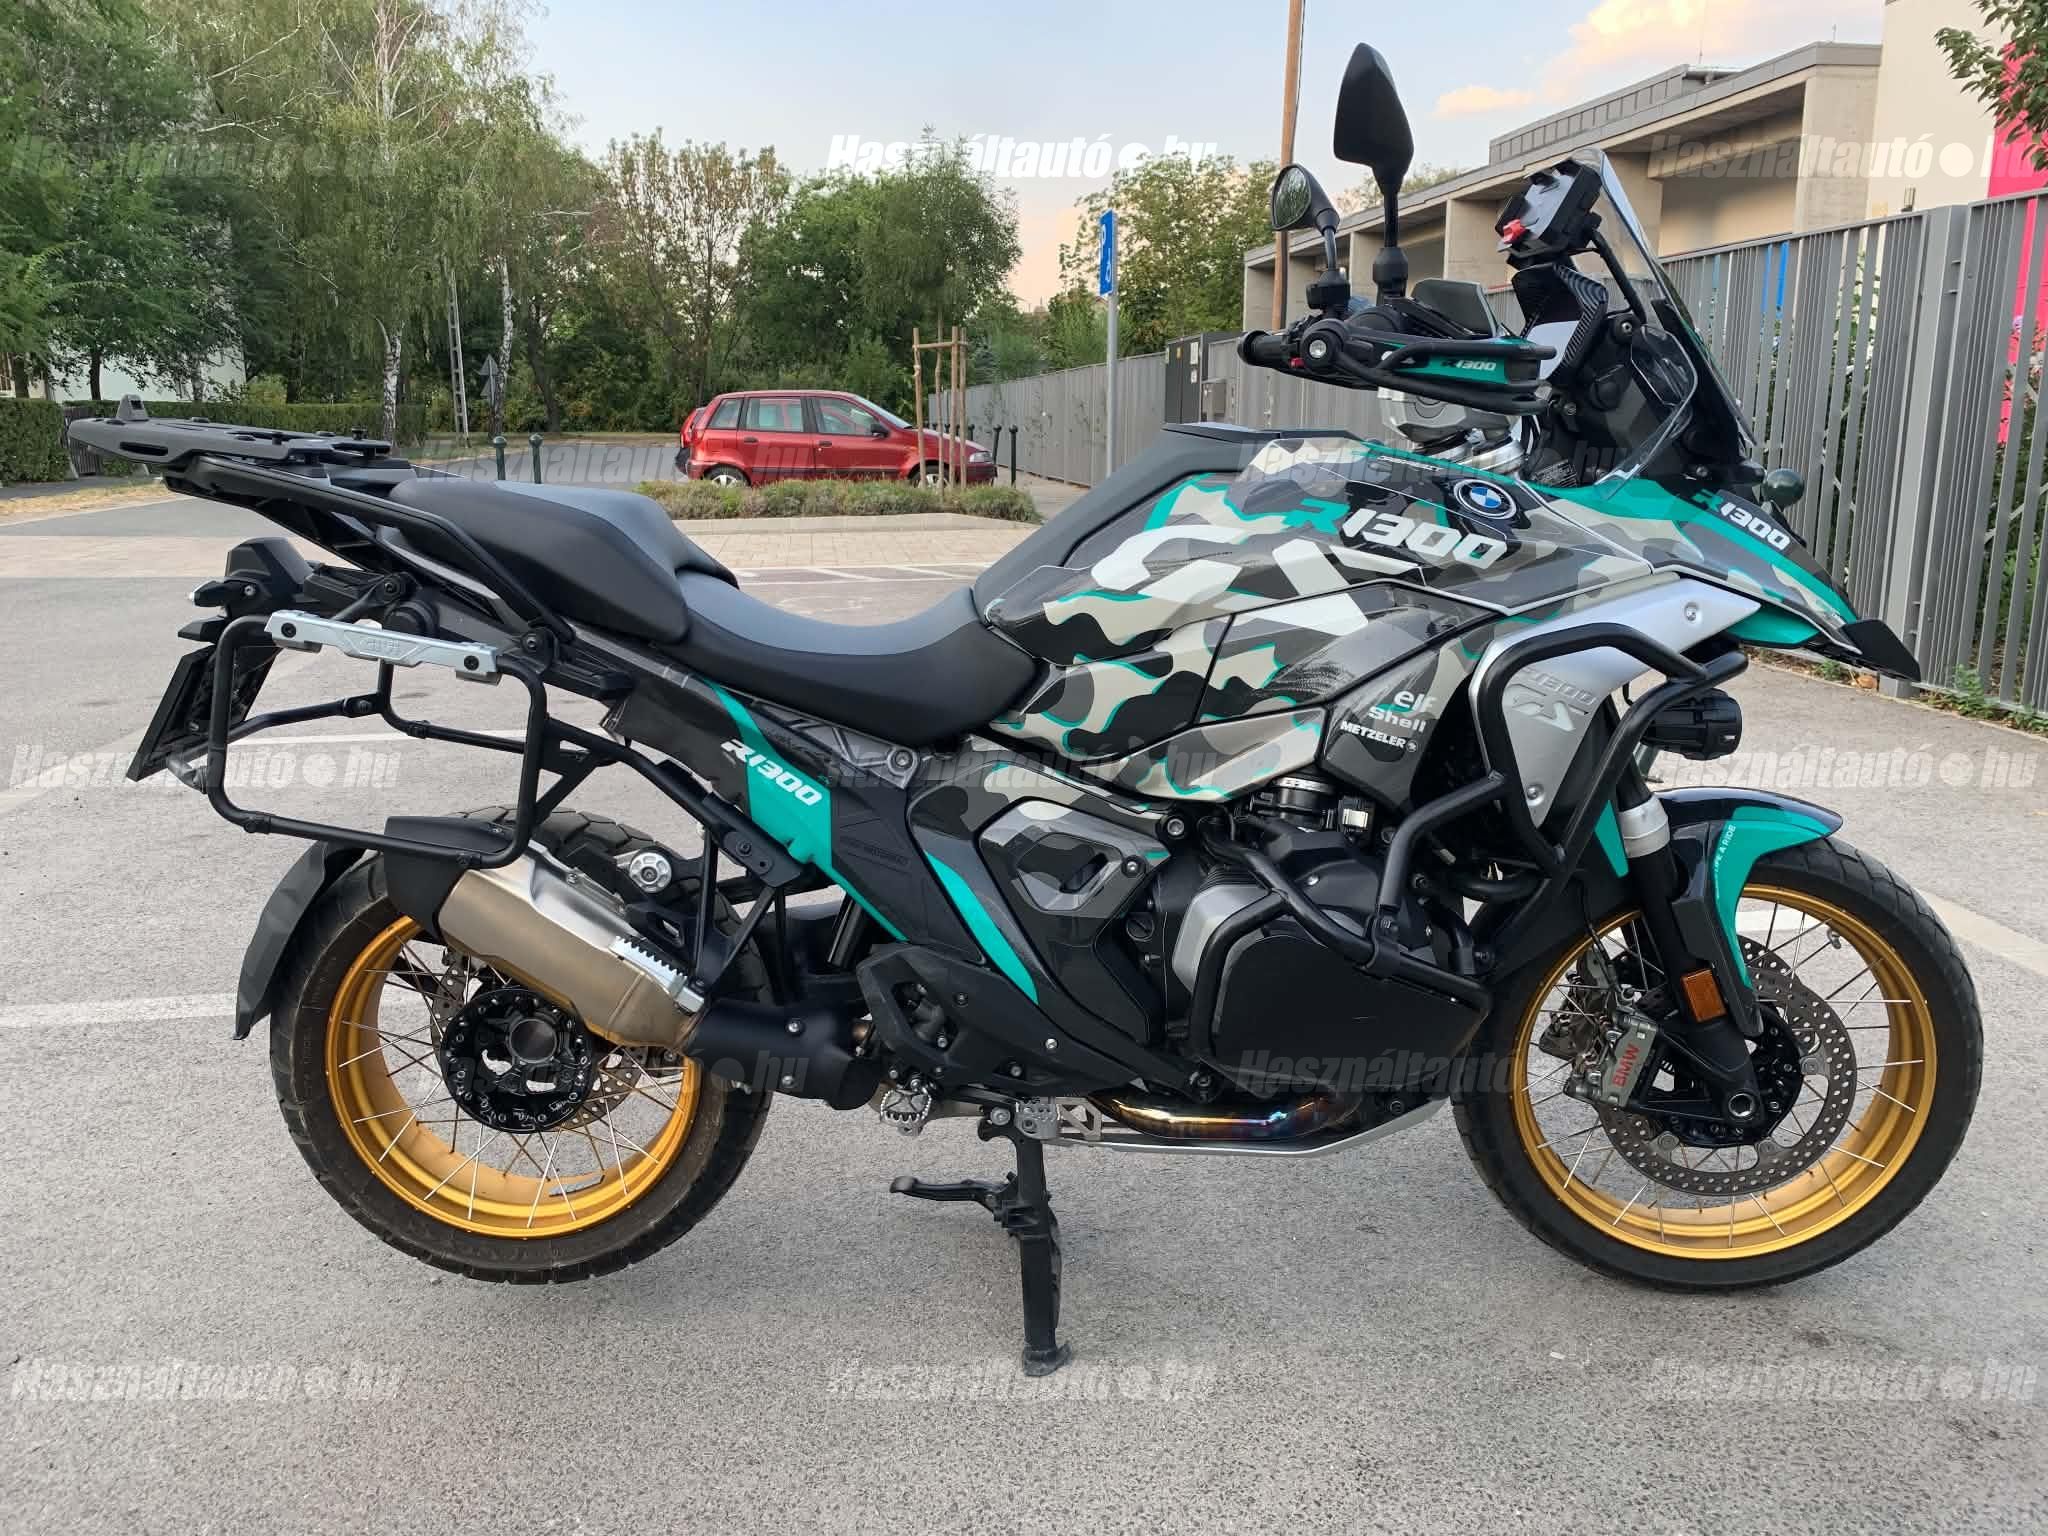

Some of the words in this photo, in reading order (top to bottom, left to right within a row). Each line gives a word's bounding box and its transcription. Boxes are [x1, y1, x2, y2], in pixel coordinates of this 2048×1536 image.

[1281, 497, 1508, 570] R1300
[1692, 488, 1790, 551] R1300
[1368, 705, 1427, 733] Shell
[1394, 690, 1437, 712] elf
[1340, 720, 1406, 749] METZELER
[721, 738, 823, 806] R1300
[1611, 1043, 1640, 1088] BMW
